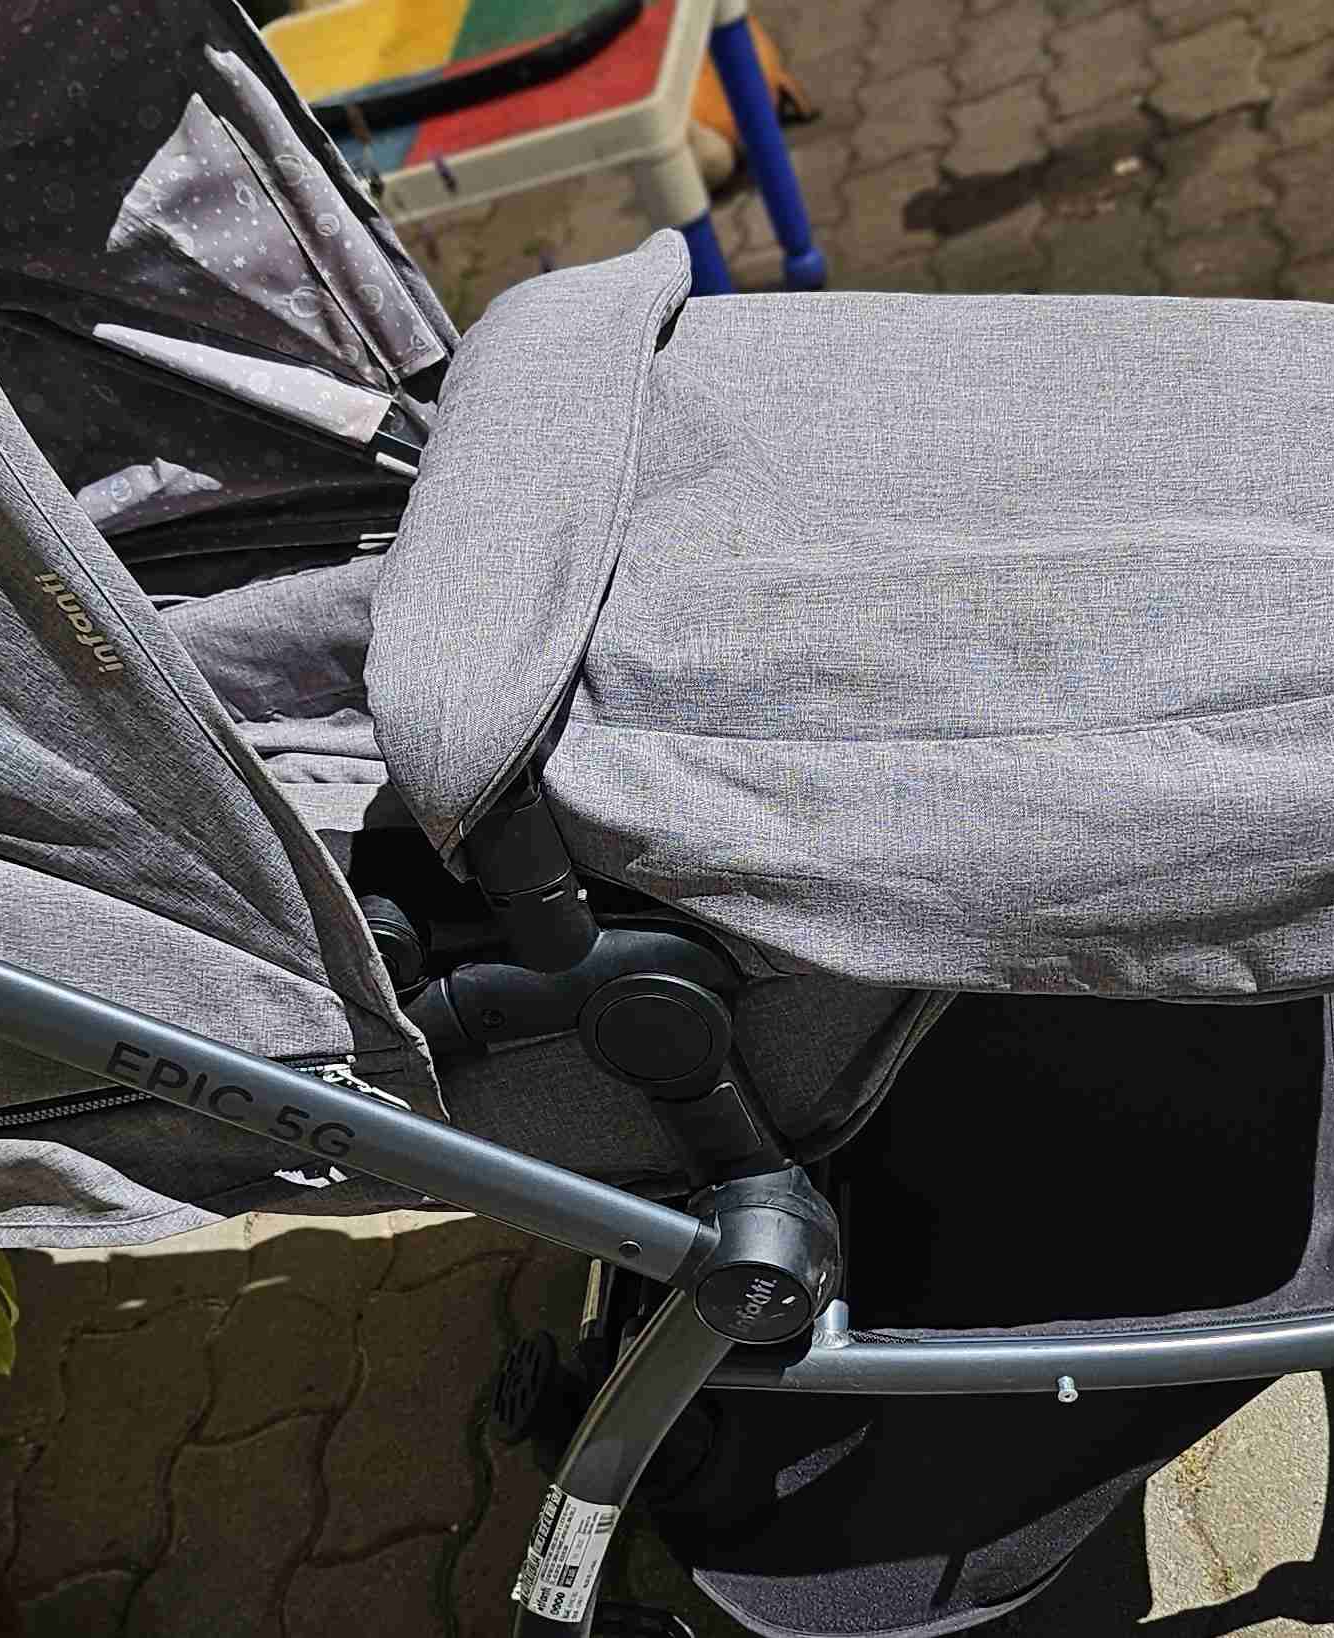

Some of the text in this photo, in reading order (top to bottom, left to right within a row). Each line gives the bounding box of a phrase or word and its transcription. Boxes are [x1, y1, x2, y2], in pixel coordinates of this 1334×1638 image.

[34, 572, 125, 673] infanti
[105, 1040, 356, 1157] EPIC 5G
